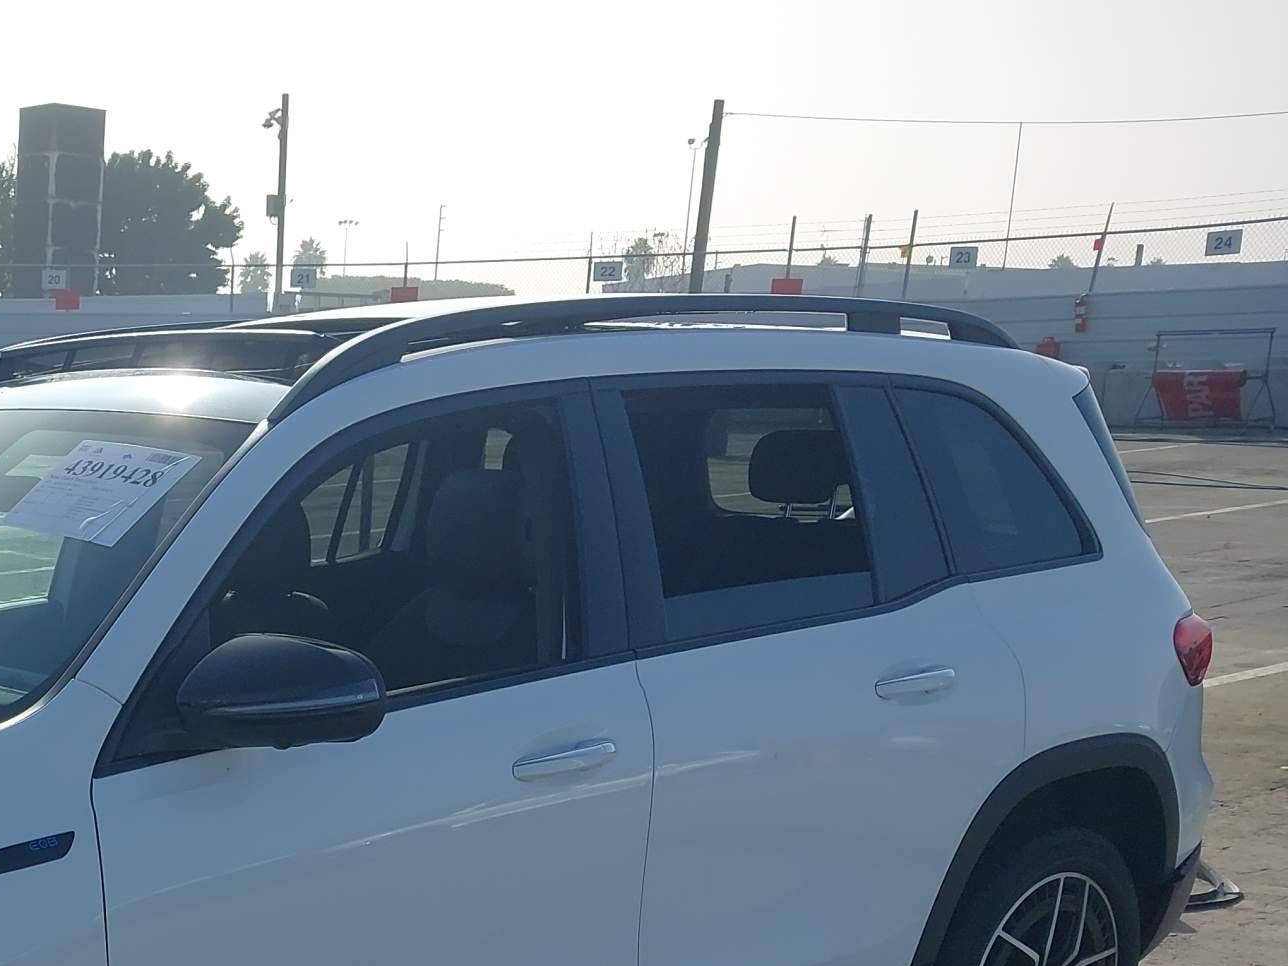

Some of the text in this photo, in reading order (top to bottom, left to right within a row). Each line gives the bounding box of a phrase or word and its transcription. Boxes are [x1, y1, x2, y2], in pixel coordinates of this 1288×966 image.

[1213, 236, 1233, 250] 24
[955, 251, 971, 264] 23
[600, 266, 616, 277] 22
[47, 274, 61, 285] 20
[296, 273, 310, 284] 21
[63, 458, 165, 488] 43919428
